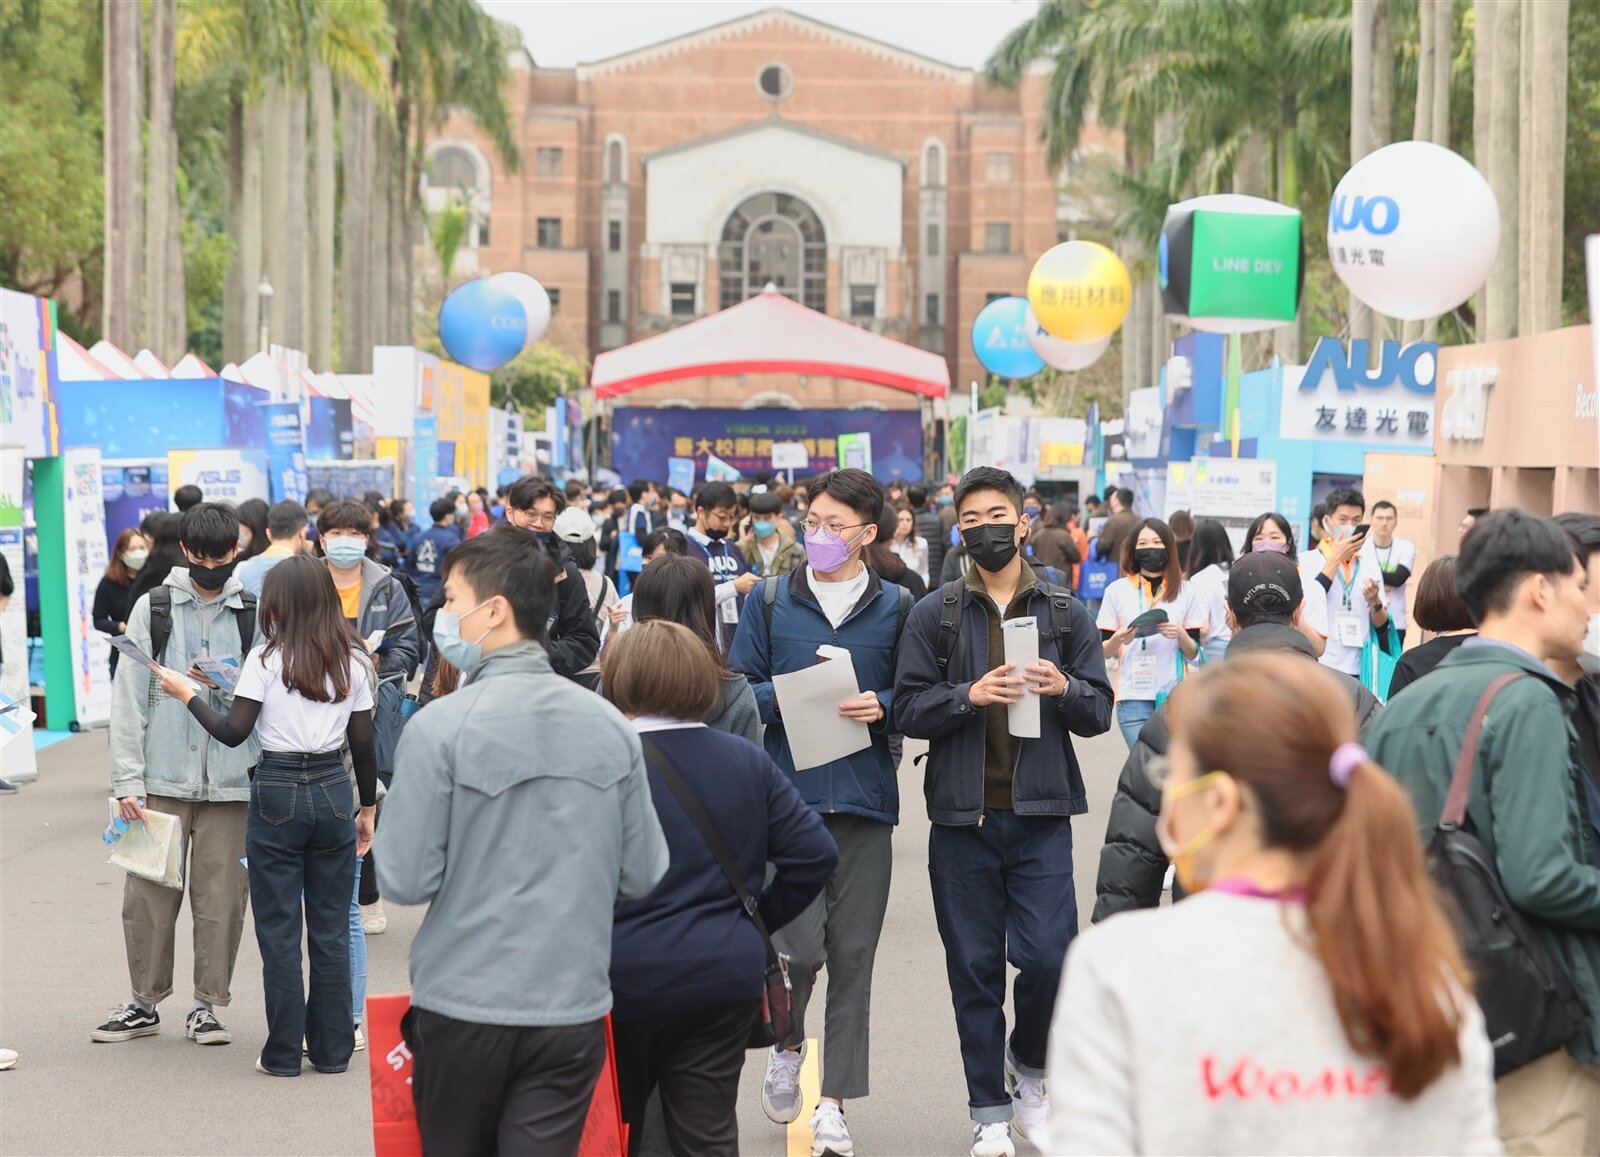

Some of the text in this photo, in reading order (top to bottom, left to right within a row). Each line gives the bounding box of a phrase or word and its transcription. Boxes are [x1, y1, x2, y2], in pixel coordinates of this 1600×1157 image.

[1212, 256, 1284, 274] LINE DEV
[1040, 285, 1125, 307] 應用材料
[1298, 335, 1437, 394] AUO
[1315, 404, 1429, 435] 友達光電
[196, 469, 241, 484] ASUS
[1243, 583, 1290, 604] FUTURE DESIGN
[386, 1040, 413, 1072] ST
